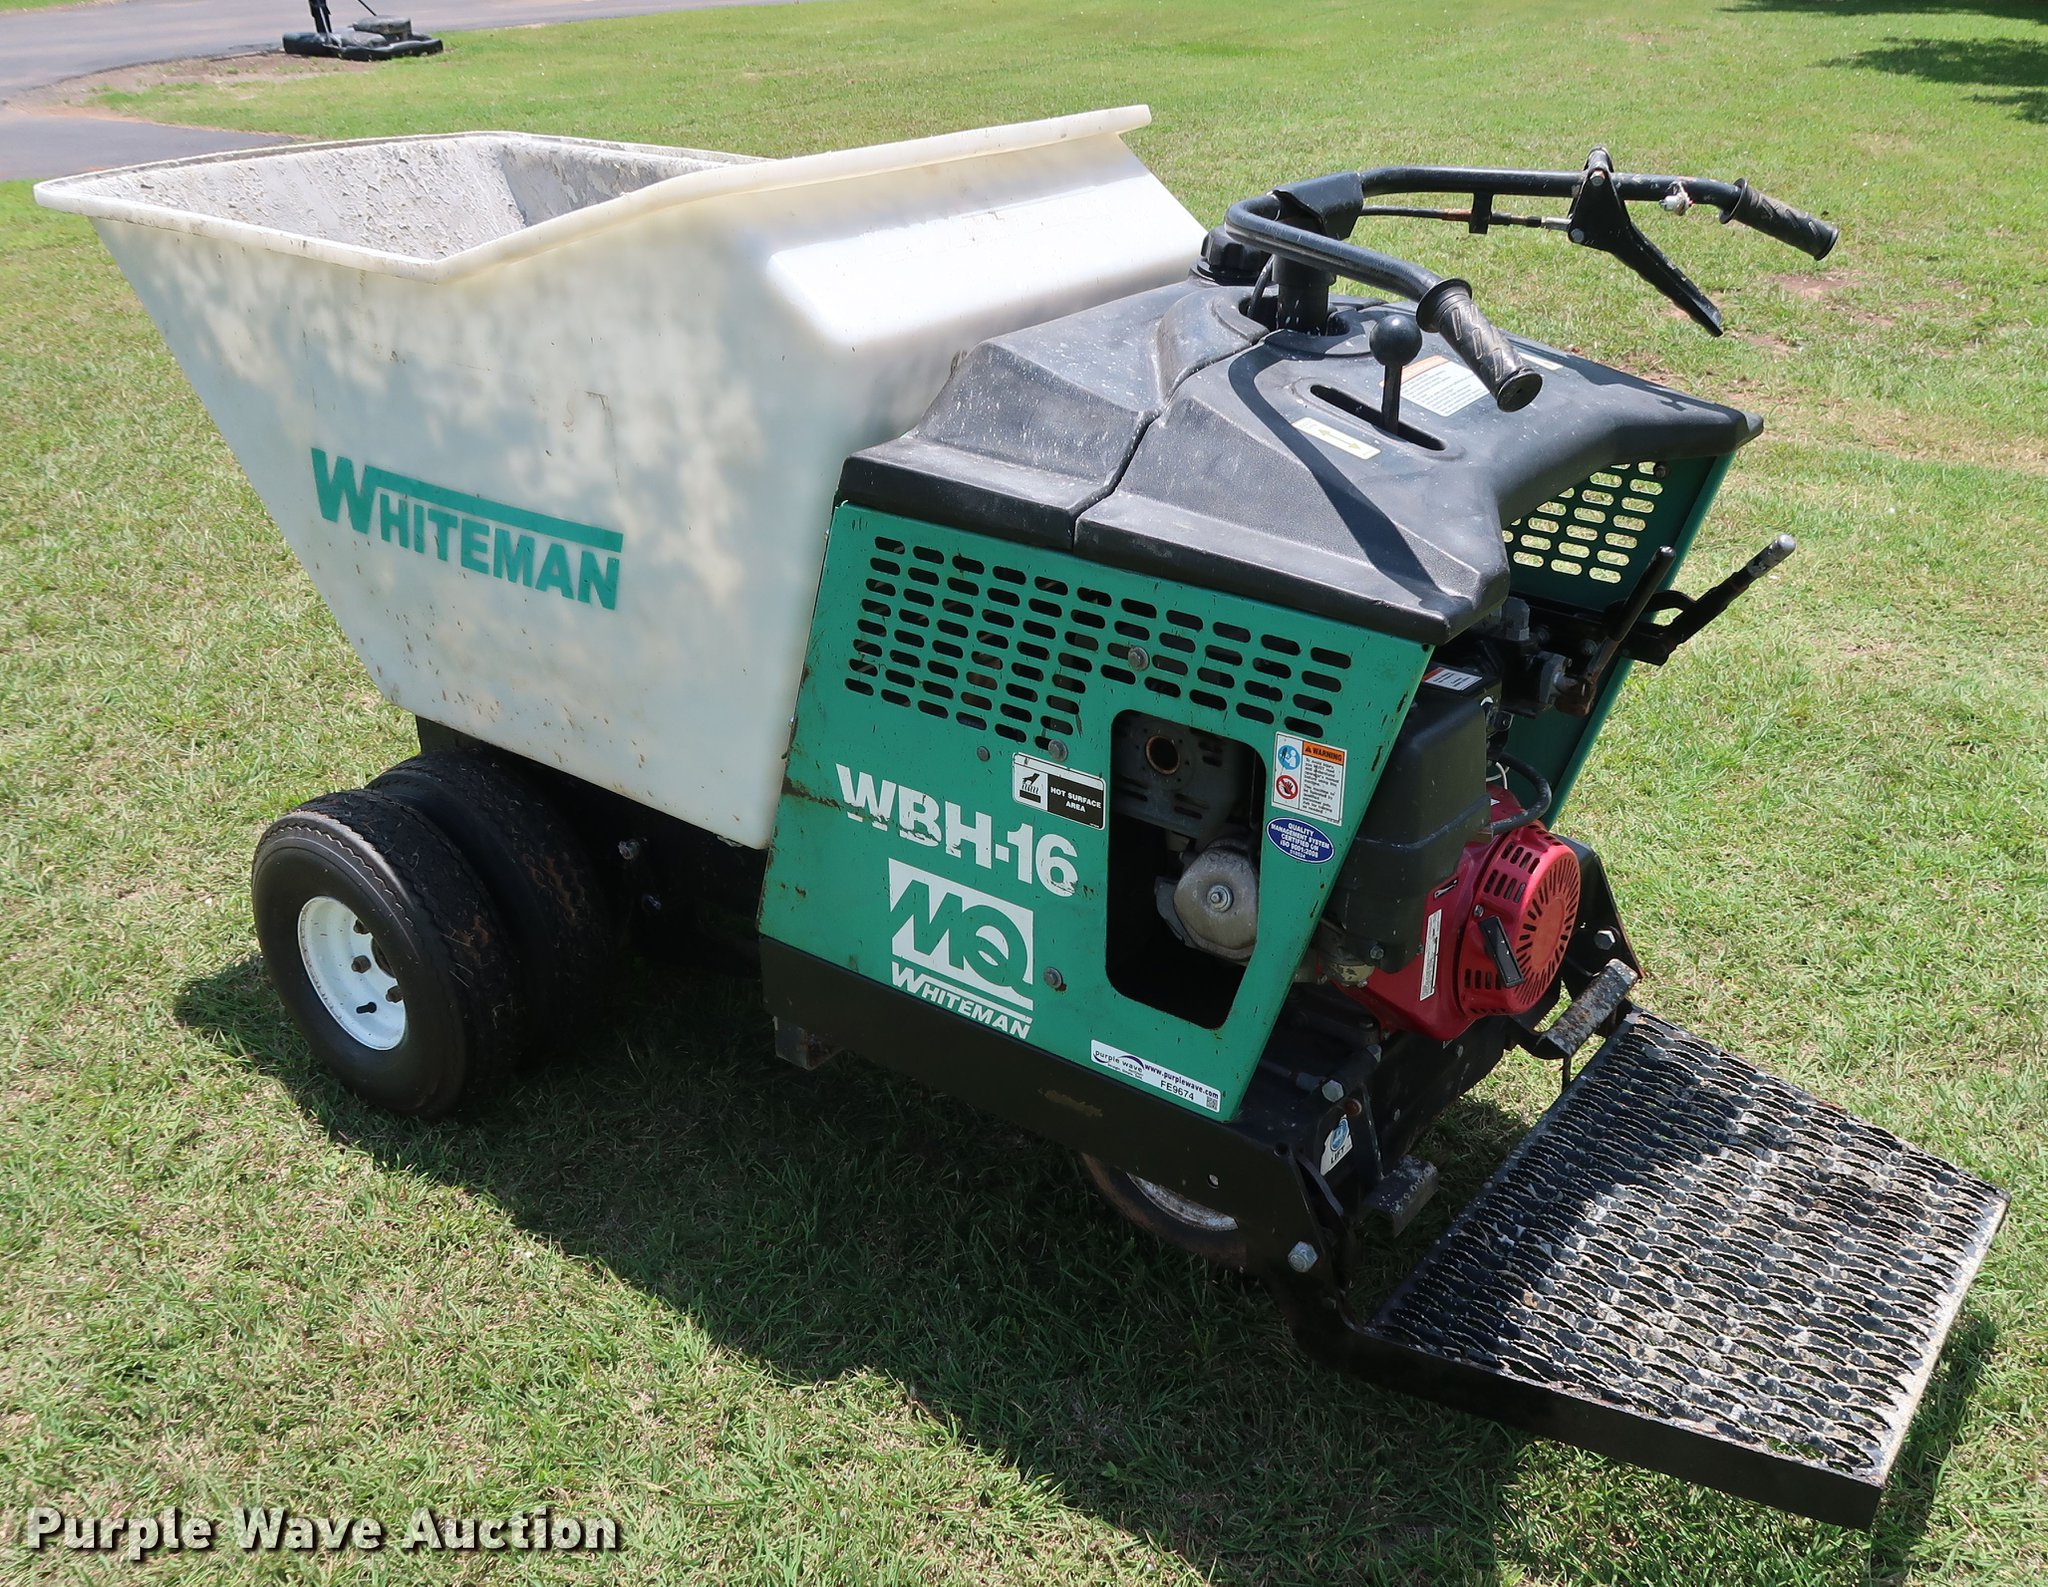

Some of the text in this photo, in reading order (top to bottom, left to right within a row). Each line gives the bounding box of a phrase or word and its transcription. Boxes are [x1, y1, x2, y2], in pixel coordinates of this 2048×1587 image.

[311, 447, 624, 611] WHITEMAN
[1312, 747, 1342, 762] WARNING
[1050, 786, 1102, 809] HOT SURFACE
[1065, 800, 1086, 813] AREA
[836, 763, 1078, 897] WBH-16
[1270, 823, 1330, 850] MANAGEMENT SYSTEM
[1280, 833, 1310, 848] CERTIFIED
[1287, 822, 1315, 837] QUALITY
[1279, 839, 1291, 849] ISO
[888, 858, 1034, 1011] MQ
[891, 961, 1034, 1040] WHITEMAN
[1095, 1050, 1120, 1063] purple
[1122, 1061, 1143, 1073] wave
[1144, 1063, 1219, 1100] www.purplewave.com
